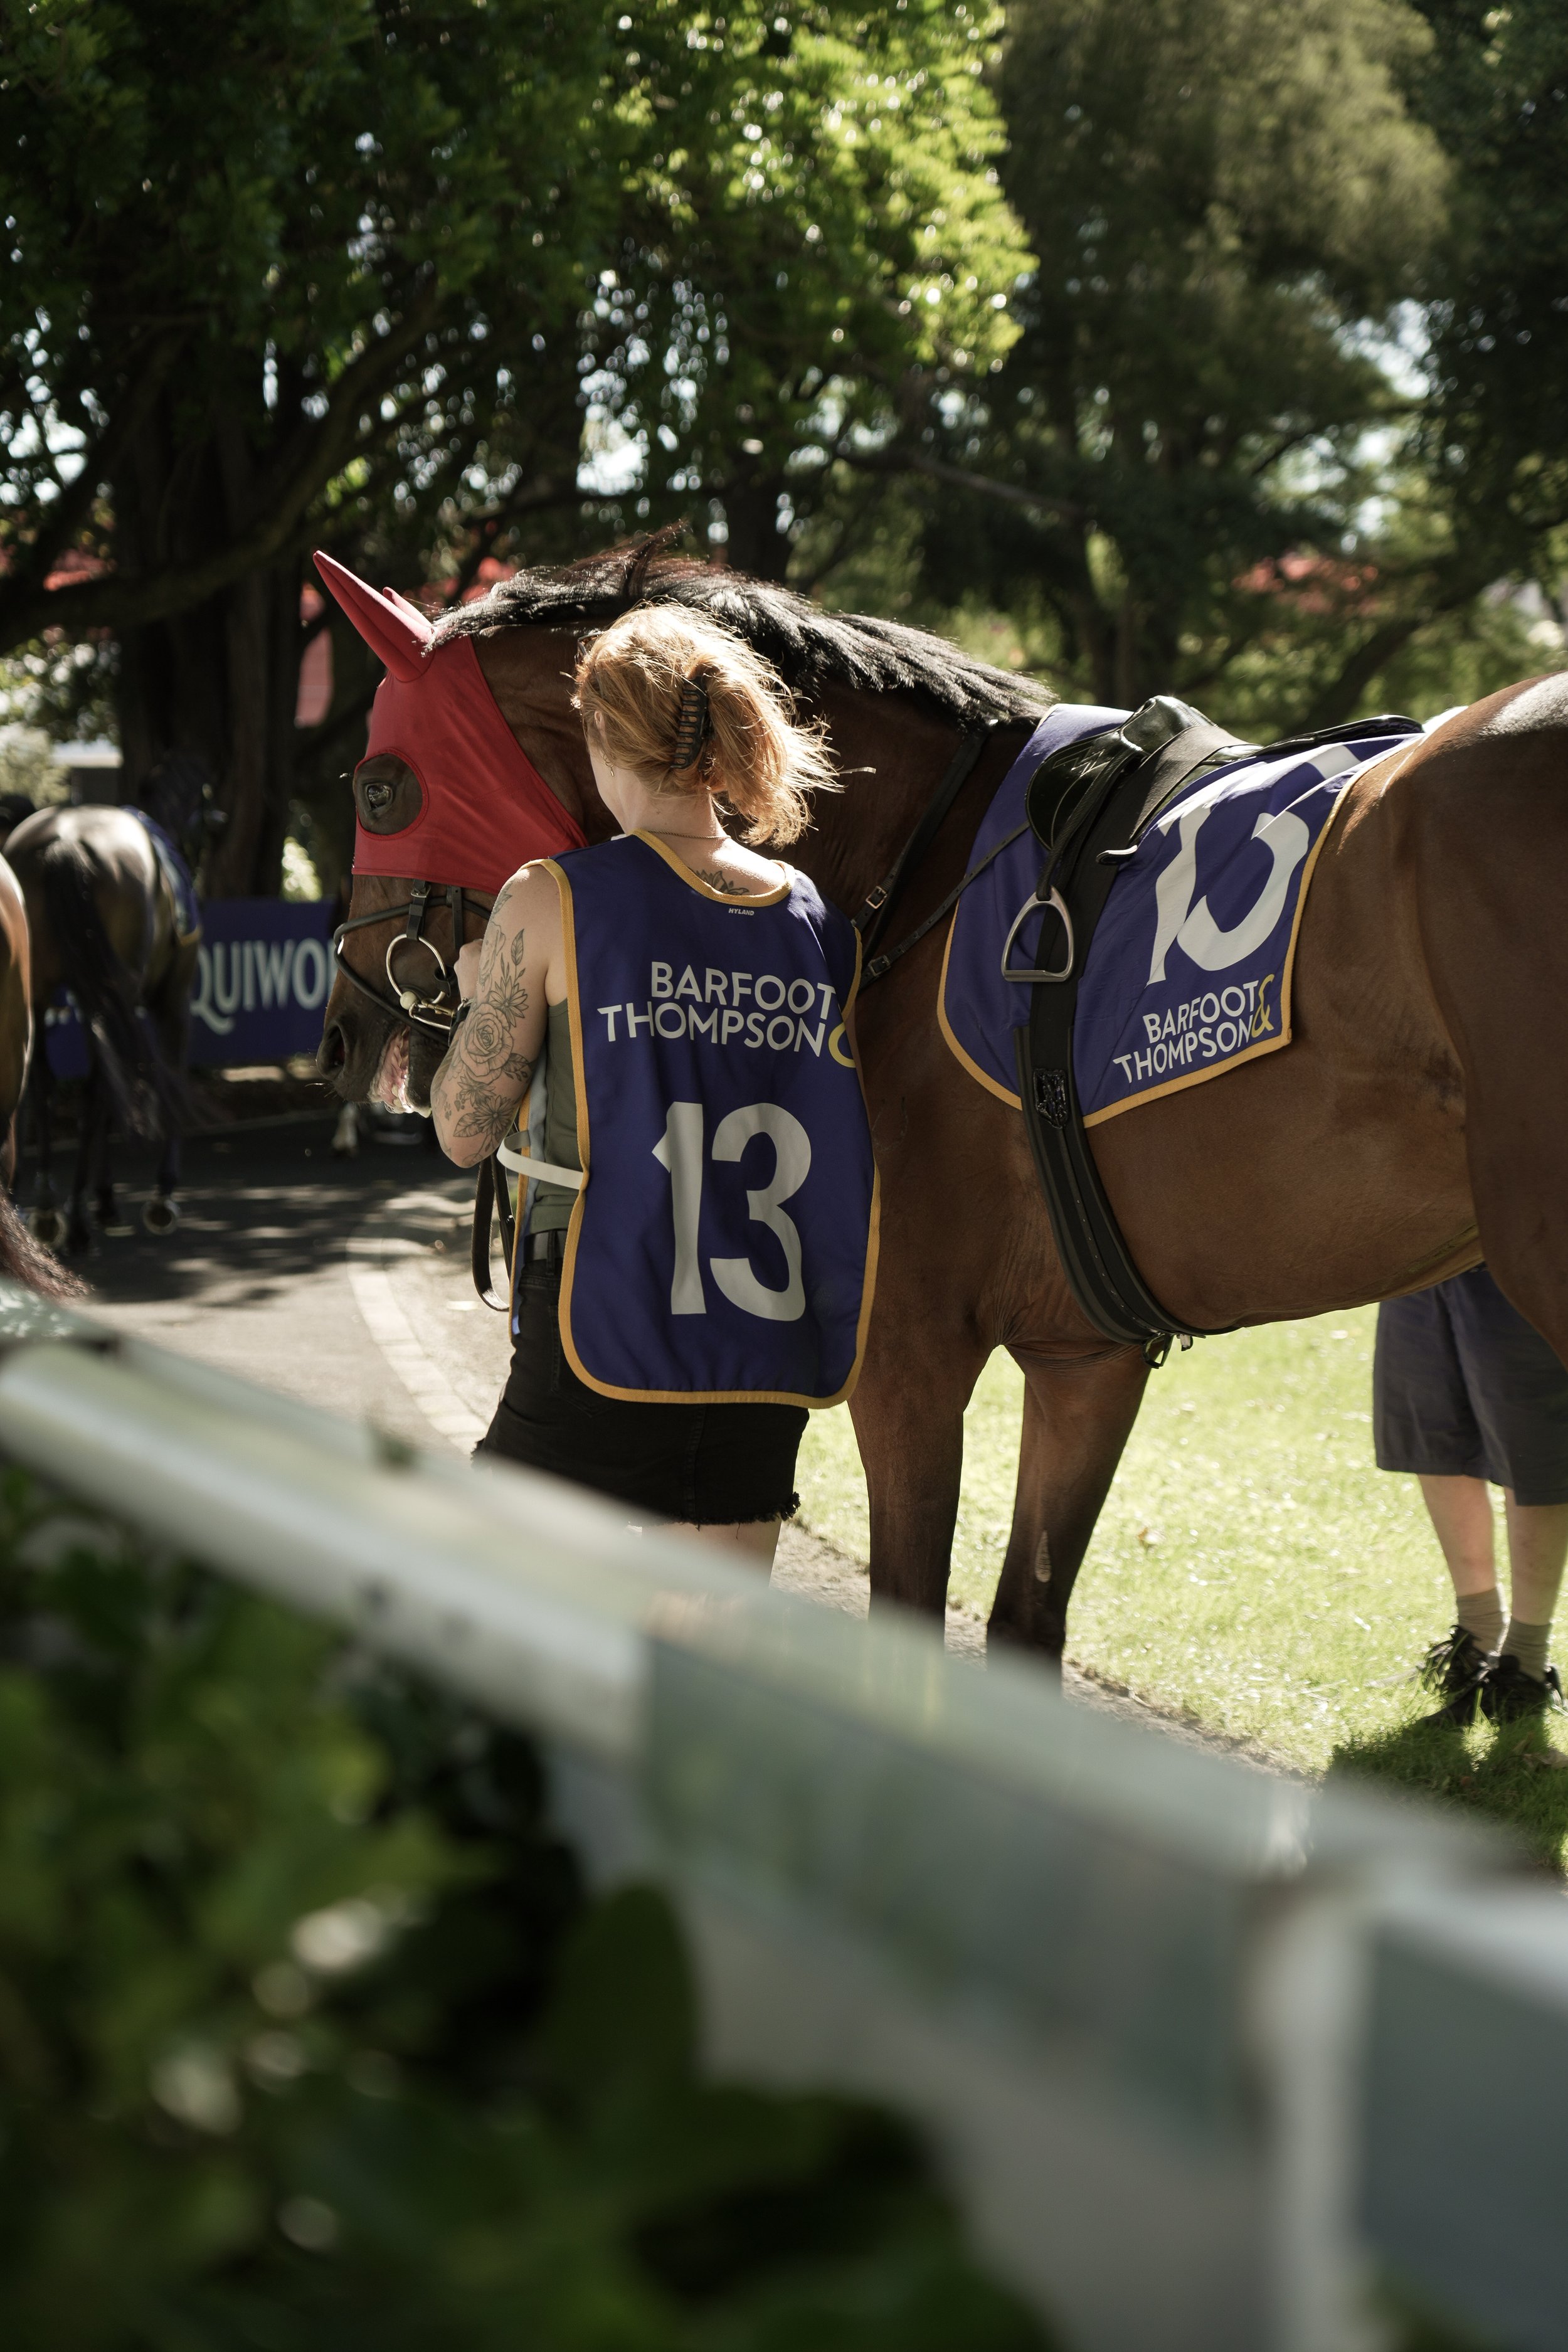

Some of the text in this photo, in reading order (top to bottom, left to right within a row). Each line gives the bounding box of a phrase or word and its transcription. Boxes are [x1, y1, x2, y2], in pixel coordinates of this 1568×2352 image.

[728, 908, 755, 916] HYLAND
[651, 961, 836, 1020] BARFOOT
[1143, 974, 1275, 1044] BARFOOT &
[598, 1002, 825, 1057] THOMPSON
[1113, 1014, 1254, 1083] THOMPSON
[652, 1101, 812, 1322] 13
